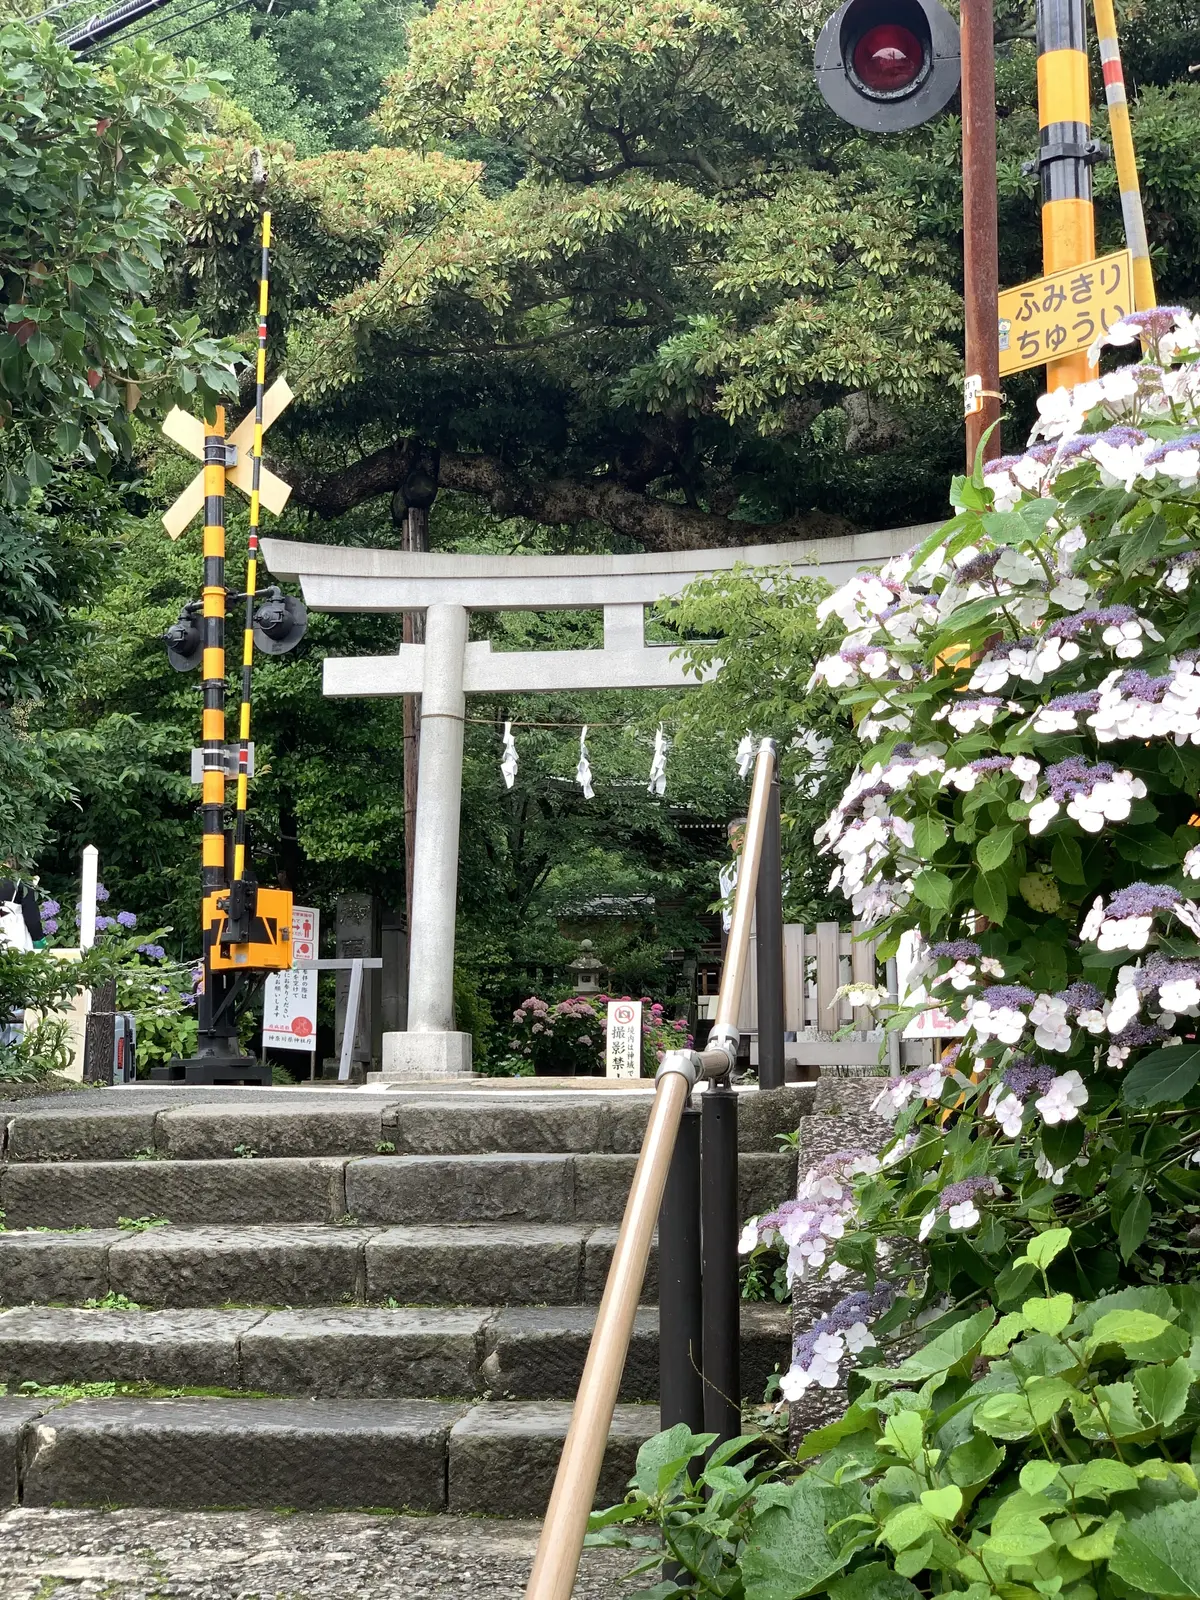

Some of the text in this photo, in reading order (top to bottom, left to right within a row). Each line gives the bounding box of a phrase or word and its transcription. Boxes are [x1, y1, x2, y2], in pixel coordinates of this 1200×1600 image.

[1015, 263, 1121, 322] ふみきり
[1016, 304, 1125, 360] ちゅうい
[611, 1025, 626, 1078] 撮影禁
